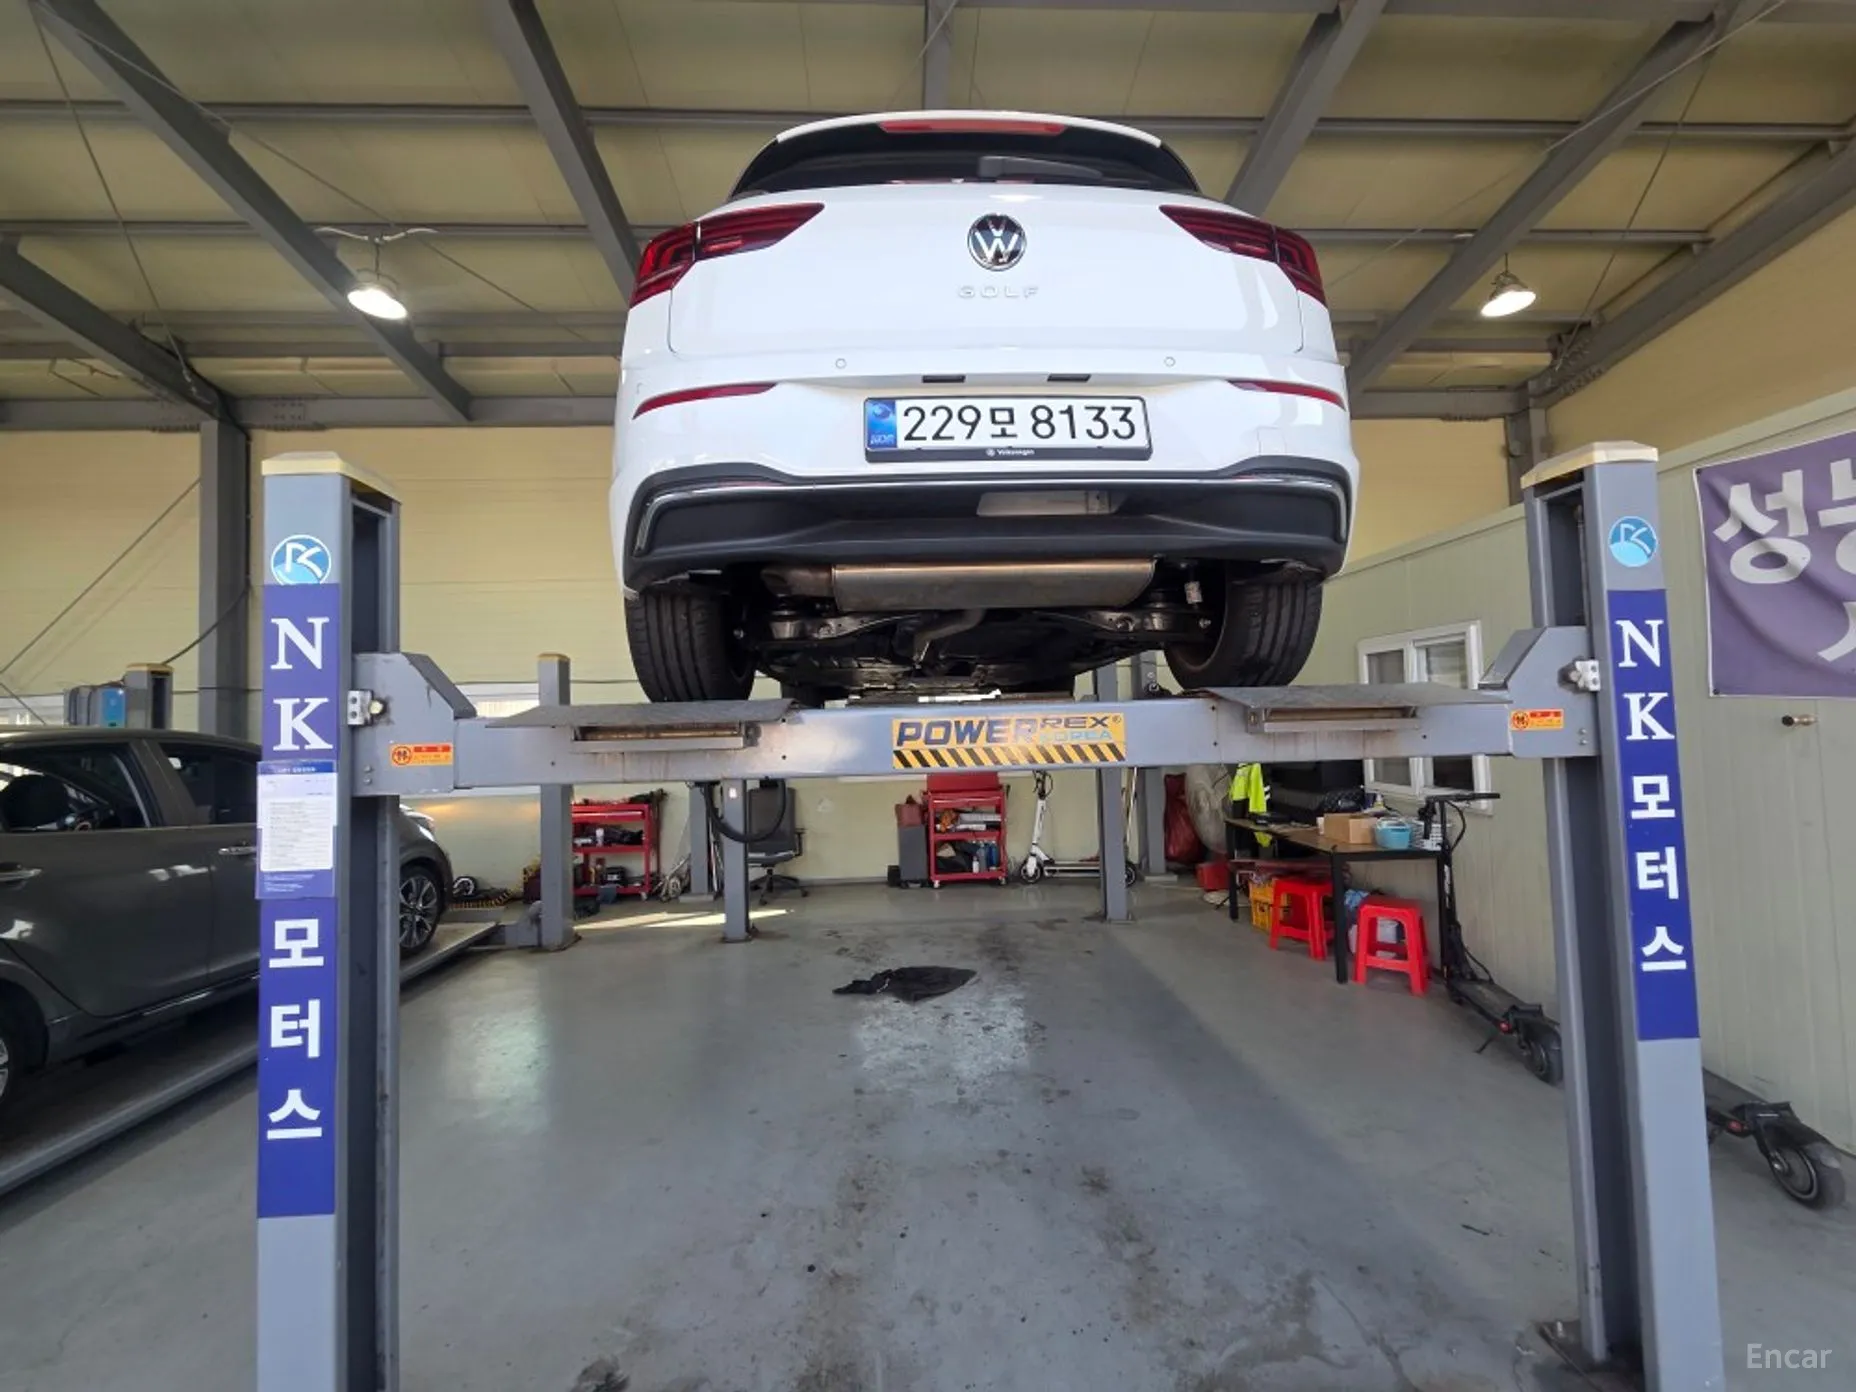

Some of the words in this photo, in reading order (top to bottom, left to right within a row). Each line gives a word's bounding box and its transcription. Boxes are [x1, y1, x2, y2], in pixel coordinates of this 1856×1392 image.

[958, 286, 1039, 299] GOLF
[903, 405, 1018, 441] 229모
[1031, 405, 1136, 440] 8133
